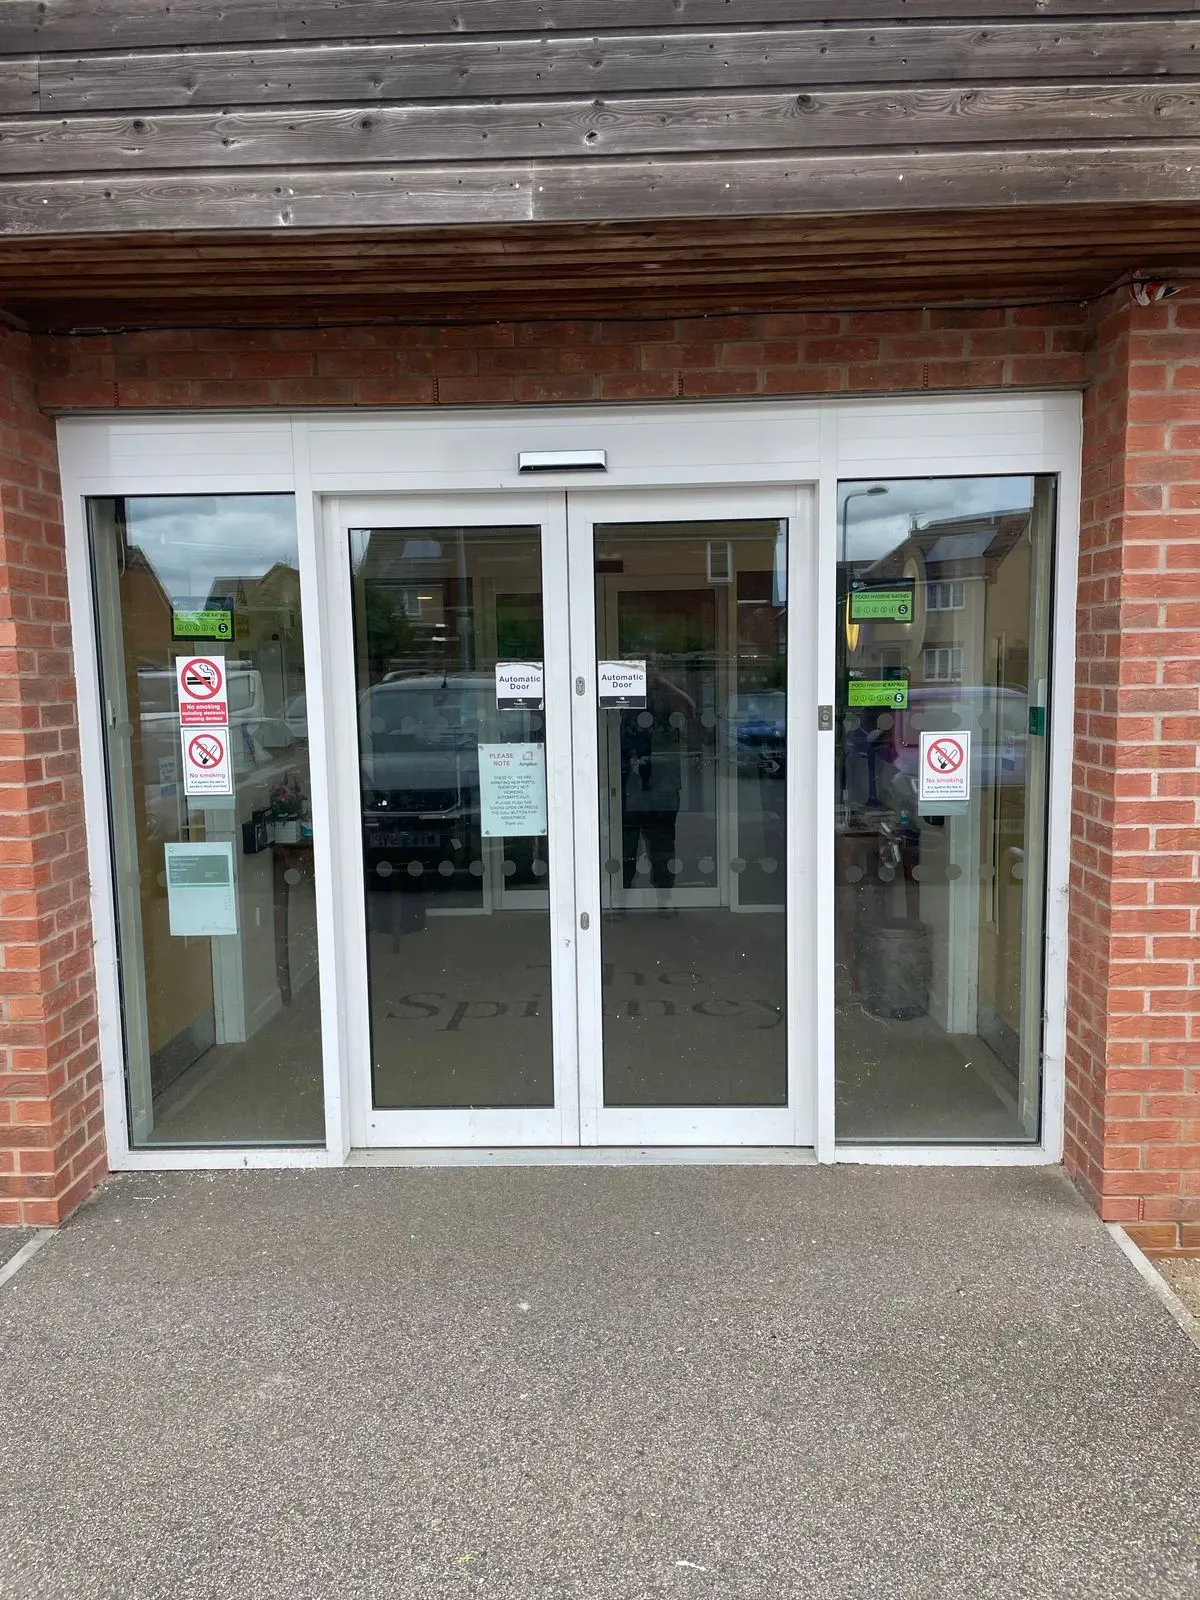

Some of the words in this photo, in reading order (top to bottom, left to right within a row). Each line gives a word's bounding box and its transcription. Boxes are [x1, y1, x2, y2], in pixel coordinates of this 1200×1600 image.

[900, 605, 906, 613] 5
[220, 624, 226, 632] 5
[896, 694, 902, 702] 5
[385, 991, 785, 1032] Spiney
